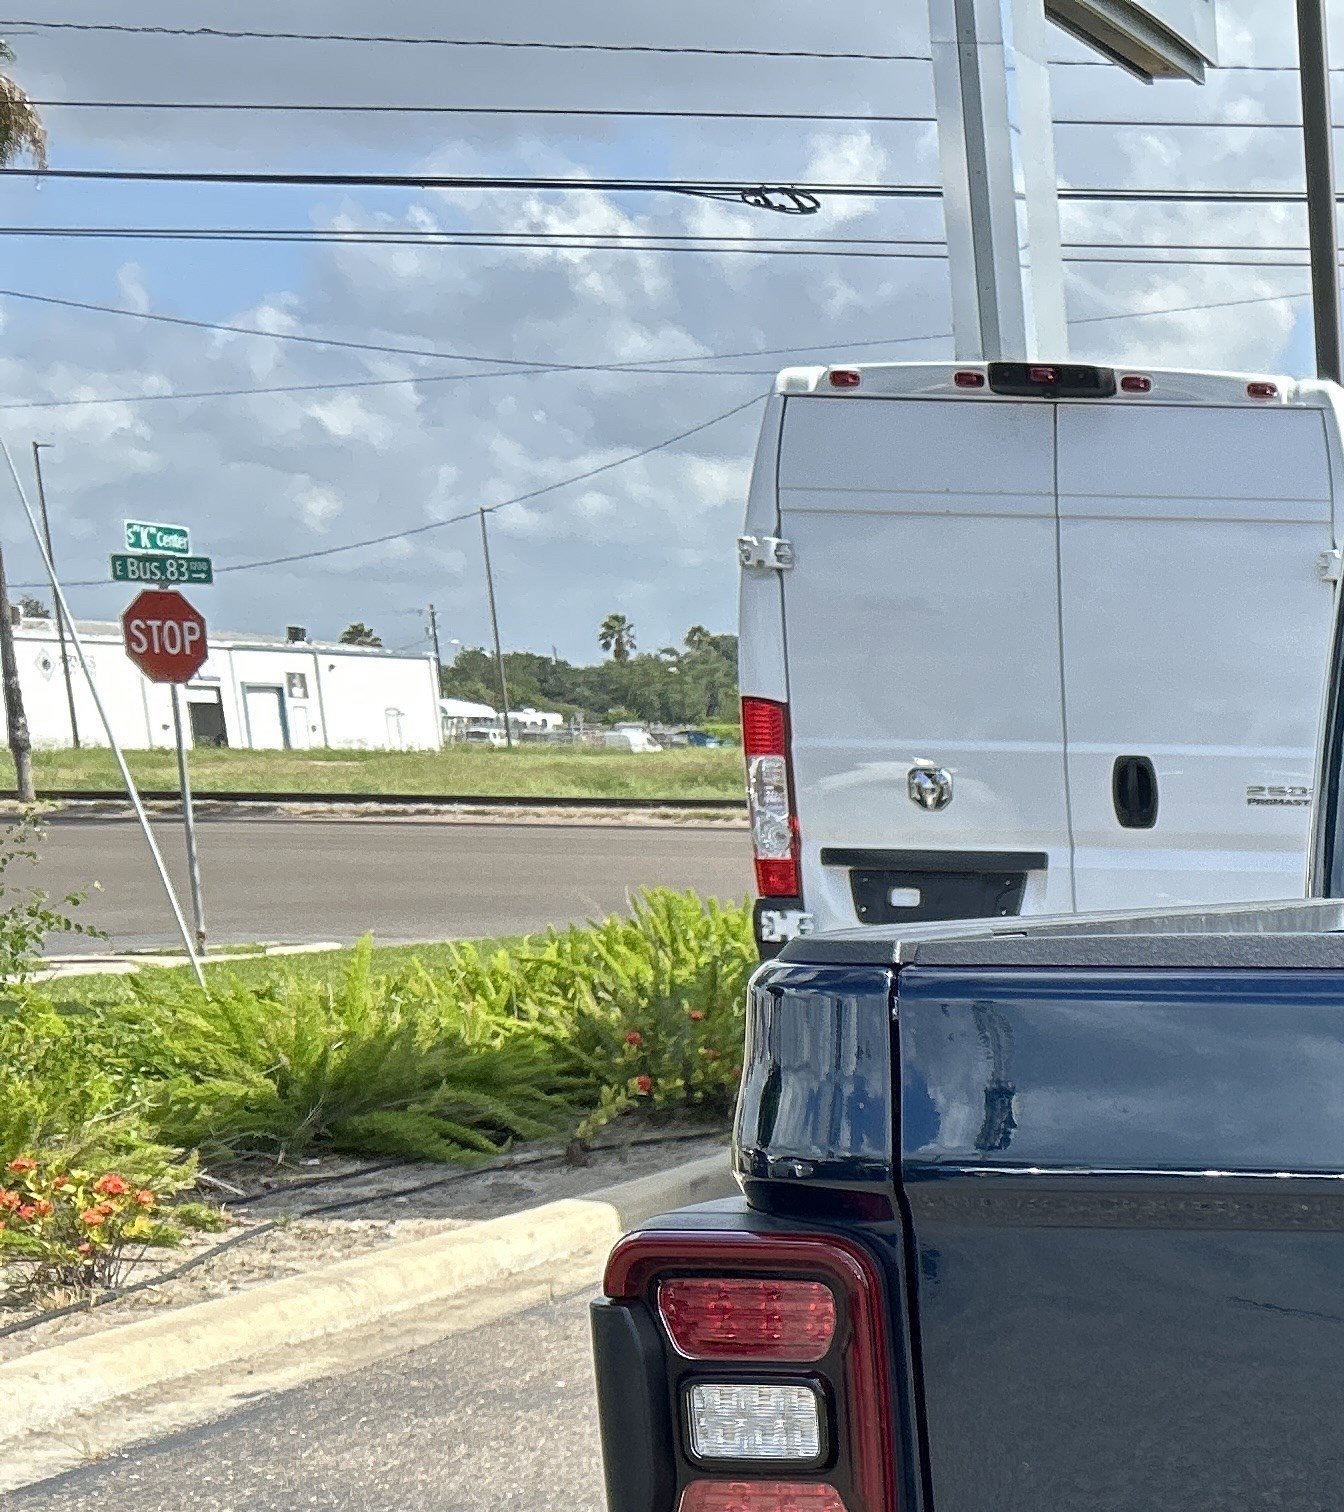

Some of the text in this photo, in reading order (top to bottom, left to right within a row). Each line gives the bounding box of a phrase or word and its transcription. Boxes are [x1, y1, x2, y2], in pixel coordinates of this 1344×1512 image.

[156, 531, 188, 550] Center
[115, 561, 123, 576] E
[130, 619, 200, 655] STOP
